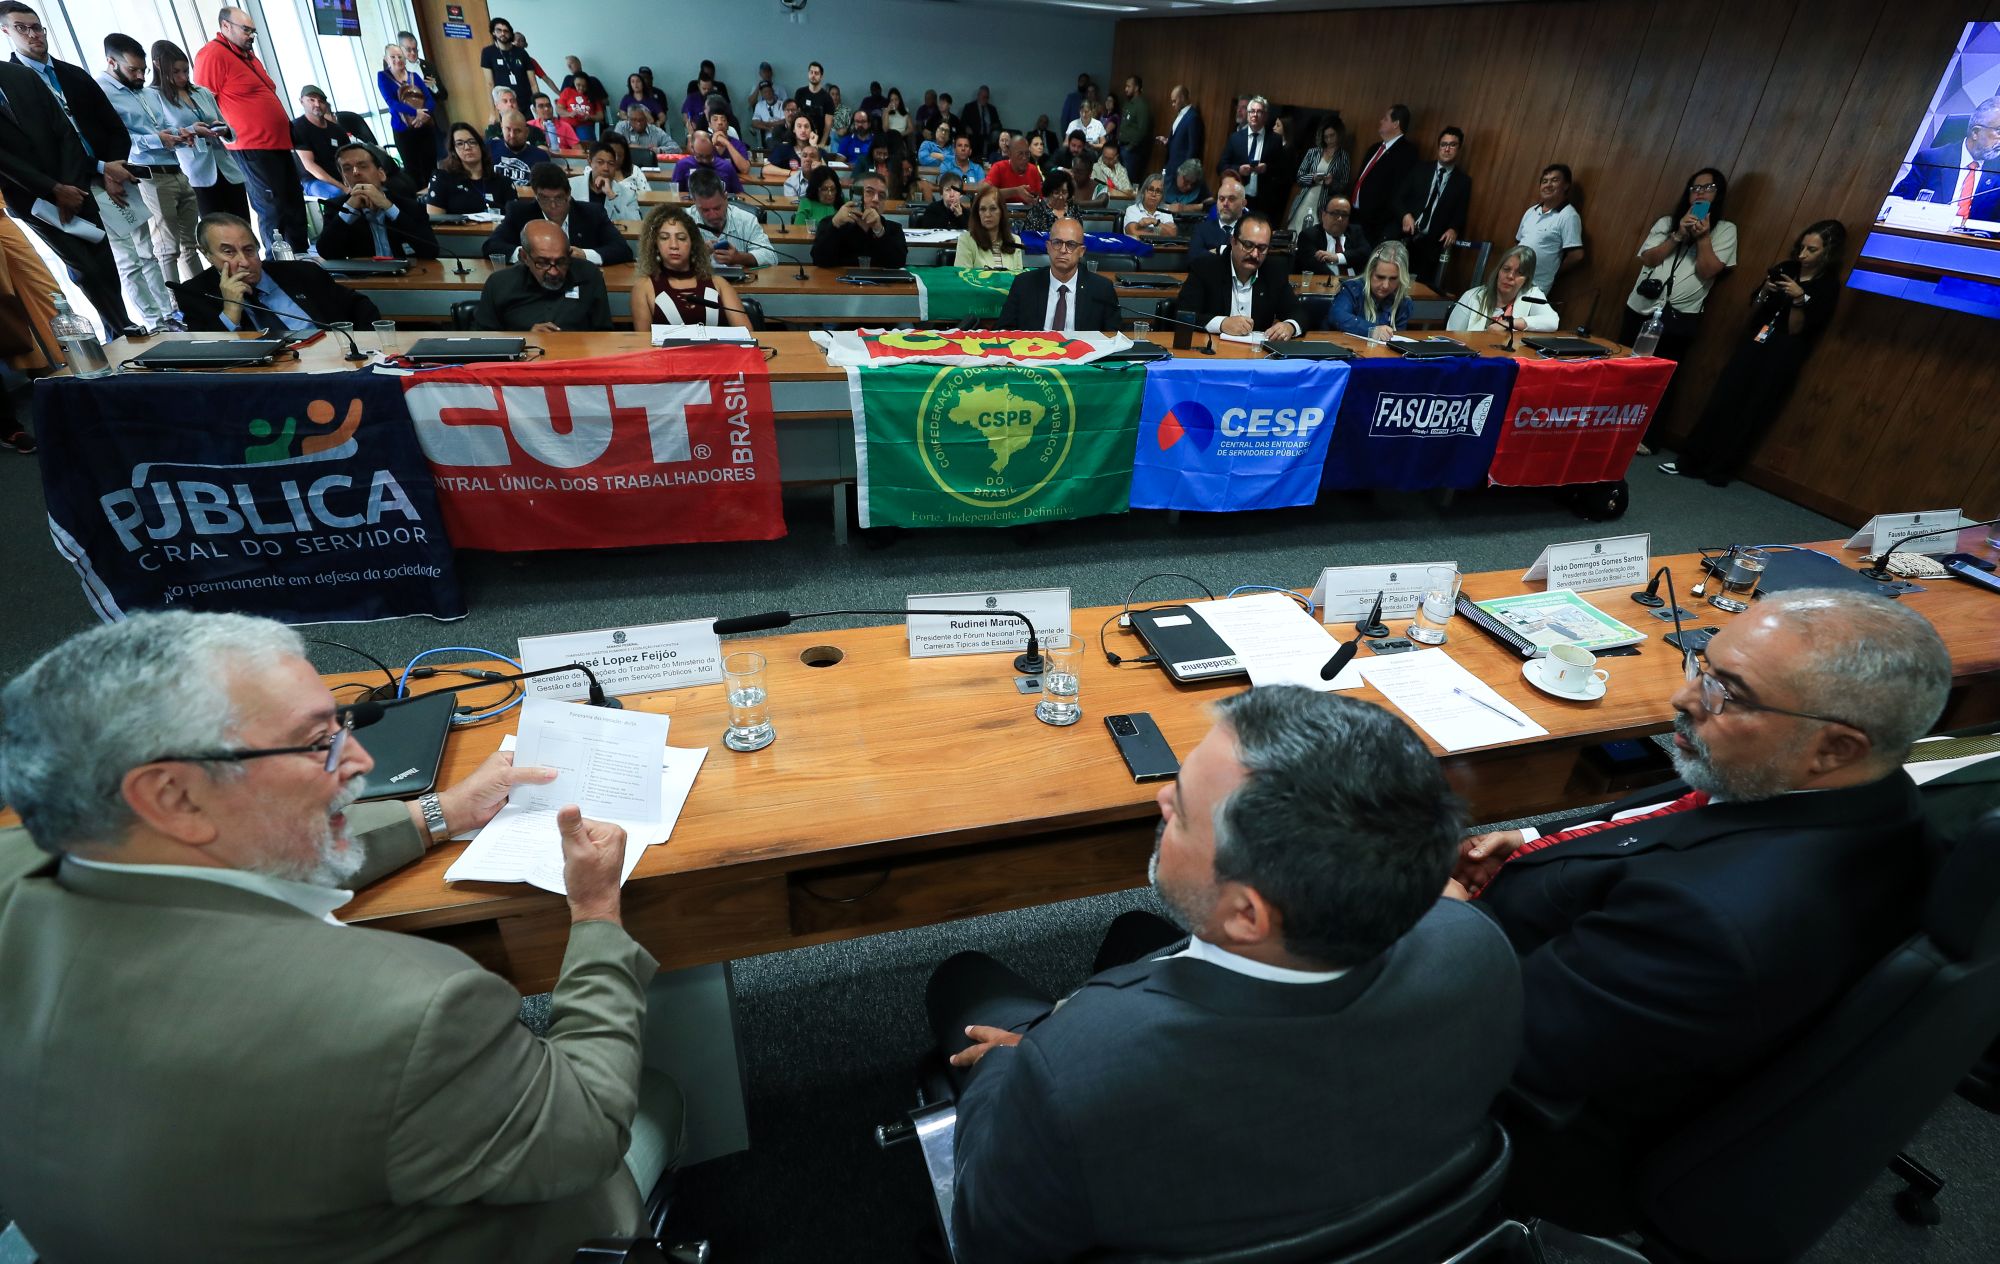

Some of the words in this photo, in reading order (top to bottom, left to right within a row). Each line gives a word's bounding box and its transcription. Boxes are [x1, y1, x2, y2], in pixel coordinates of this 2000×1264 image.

[878, 331, 1067, 356] CTB
[723, 371, 755, 464] BRASIL
[978, 409, 1032, 428] CSPB
[1376, 397, 1472, 428] FASUBRA
[1514, 403, 1643, 429] CONFETAM
[404, 380, 712, 468] CUT
[930, 375, 964, 469] CONFEDERAÇÃO
[1040, 403, 1063, 463] PÚBLICOS
[1220, 407, 1325, 437] CESP
[1220, 440, 1252, 448] CENTRAL
[1228, 449, 1275, 457] SERVIDORES
[1275, 447, 1309, 457] PÚBLIC
[434, 475, 495, 491] NTRAL
[499, 473, 558, 491] ÚNICA
[561, 476, 598, 492] DOS
[603, 467, 756, 490] TRABALHADORES
[986, 476, 1004, 486] DO
[973, 487, 1018, 498] BRASIL
[1024, 506, 1075, 518] Definitiva
[138, 541, 229, 571] CRAL
[240, 539, 282, 556] DO
[296, 526, 428, 554] SERVIDOR
[1552, 564, 1568, 572] João
[1569, 560, 1600, 570] Domingos
[1601, 558, 1622, 566] Gomes
[1623, 555, 1644, 563] Santos
[188, 574, 286, 598] permanente
[288, 574, 312, 586] em
[314, 570, 360, 586] defesa
[363, 568, 381, 581] da
[383, 563, 442, 579] sociedade
[1562, 571, 1587, 579] Presidente
[1627, 571, 1641, 579] CSPB
[1389, 595, 1408, 603] Paulo
[950, 619, 987, 629] Rudinei
[990, 618, 1026, 628] Marque
[916, 634, 952, 642] Presidente
[963, 631, 985, 639] Fórum
[986, 630, 1015, 638] Nacional
[1016, 628, 1055, 636] Peranente
[923, 642, 955, 650] Carreiras
[603, 655, 639, 666] Lopez
[641, 650, 677, 661] Feijóo
[532, 673, 570, 684] Secretário
[582, 669, 616, 678] Rlações
[630, 663, 660, 672] Trabalho
[672, 659, 705, 667] Ministério
[536, 682, 564, 692] Gestão
[631, 672, 662, 680] Serviços
[663, 669, 692, 677] Públicos
[698, 665, 713, 673] MGI
